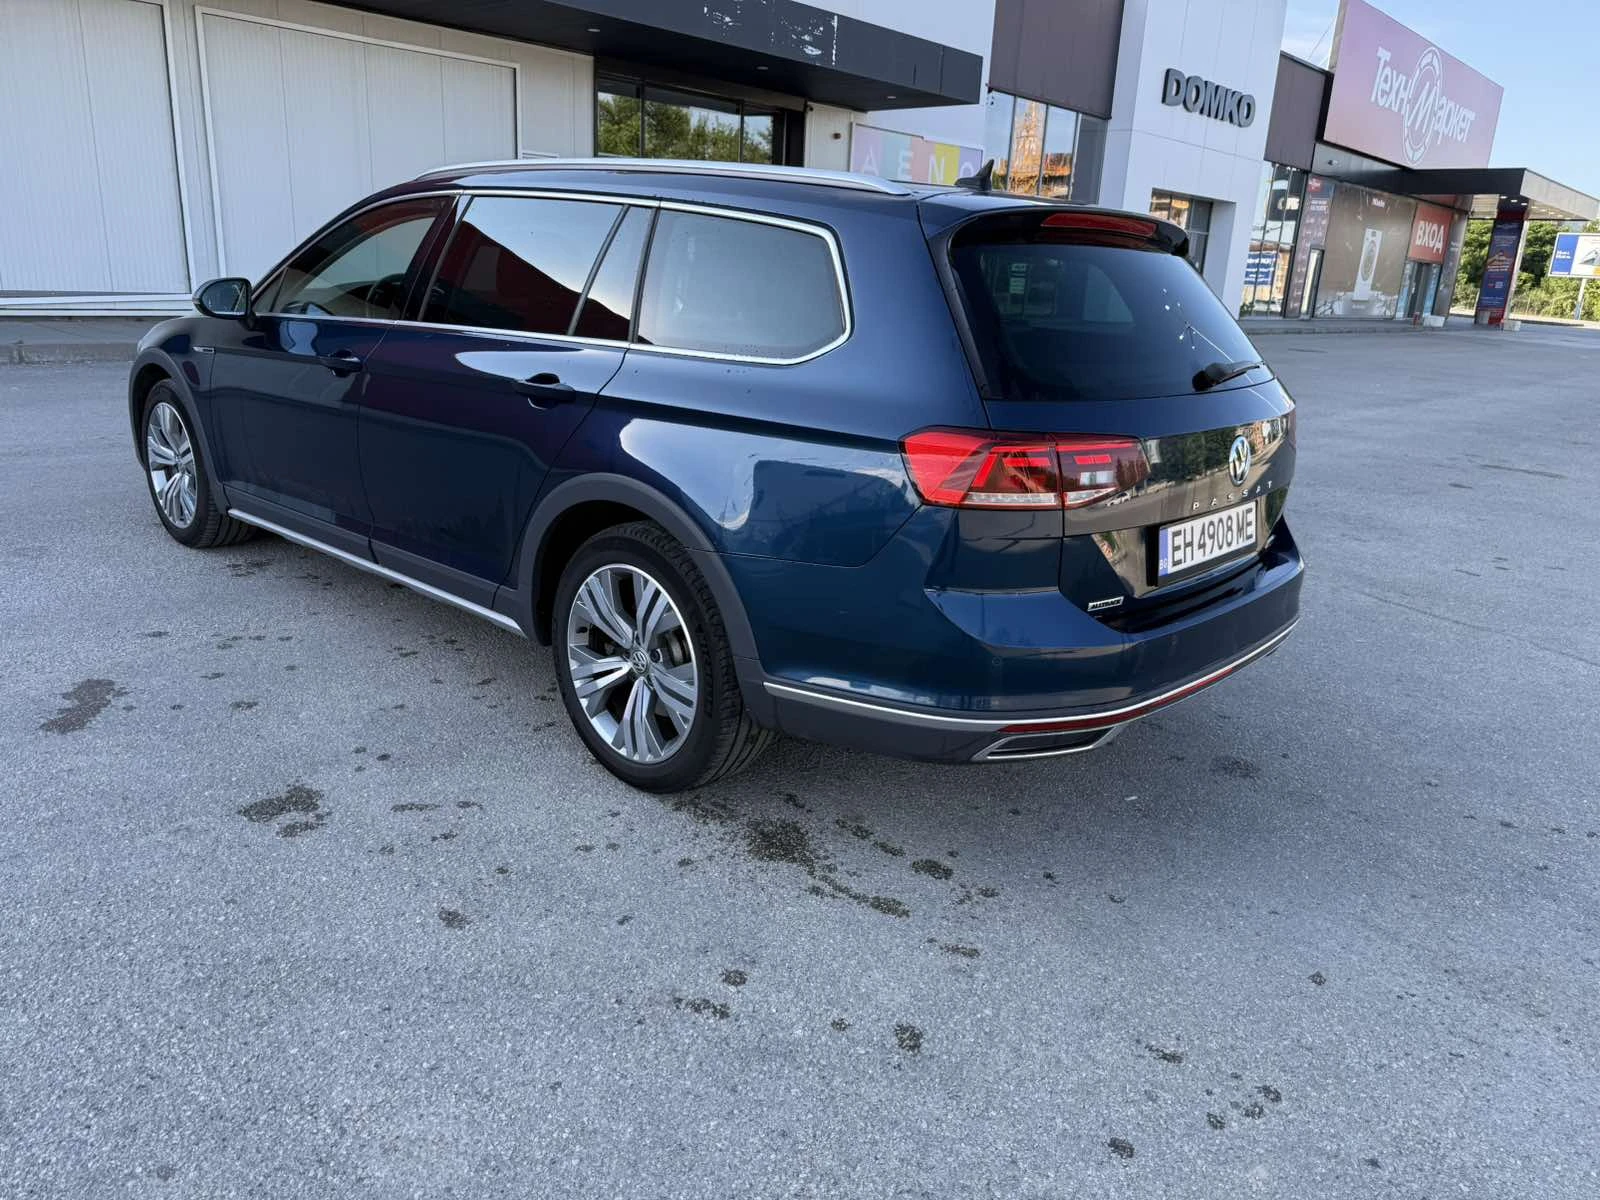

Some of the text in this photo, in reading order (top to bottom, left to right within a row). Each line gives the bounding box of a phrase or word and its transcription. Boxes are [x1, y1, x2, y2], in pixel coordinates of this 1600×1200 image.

[1161, 68, 1255, 127] DOMKO
[1415, 220, 1445, 255] ВХОД
[1192, 480, 1273, 511] PASSAT
[1197, 514, 1234, 558] 4908
